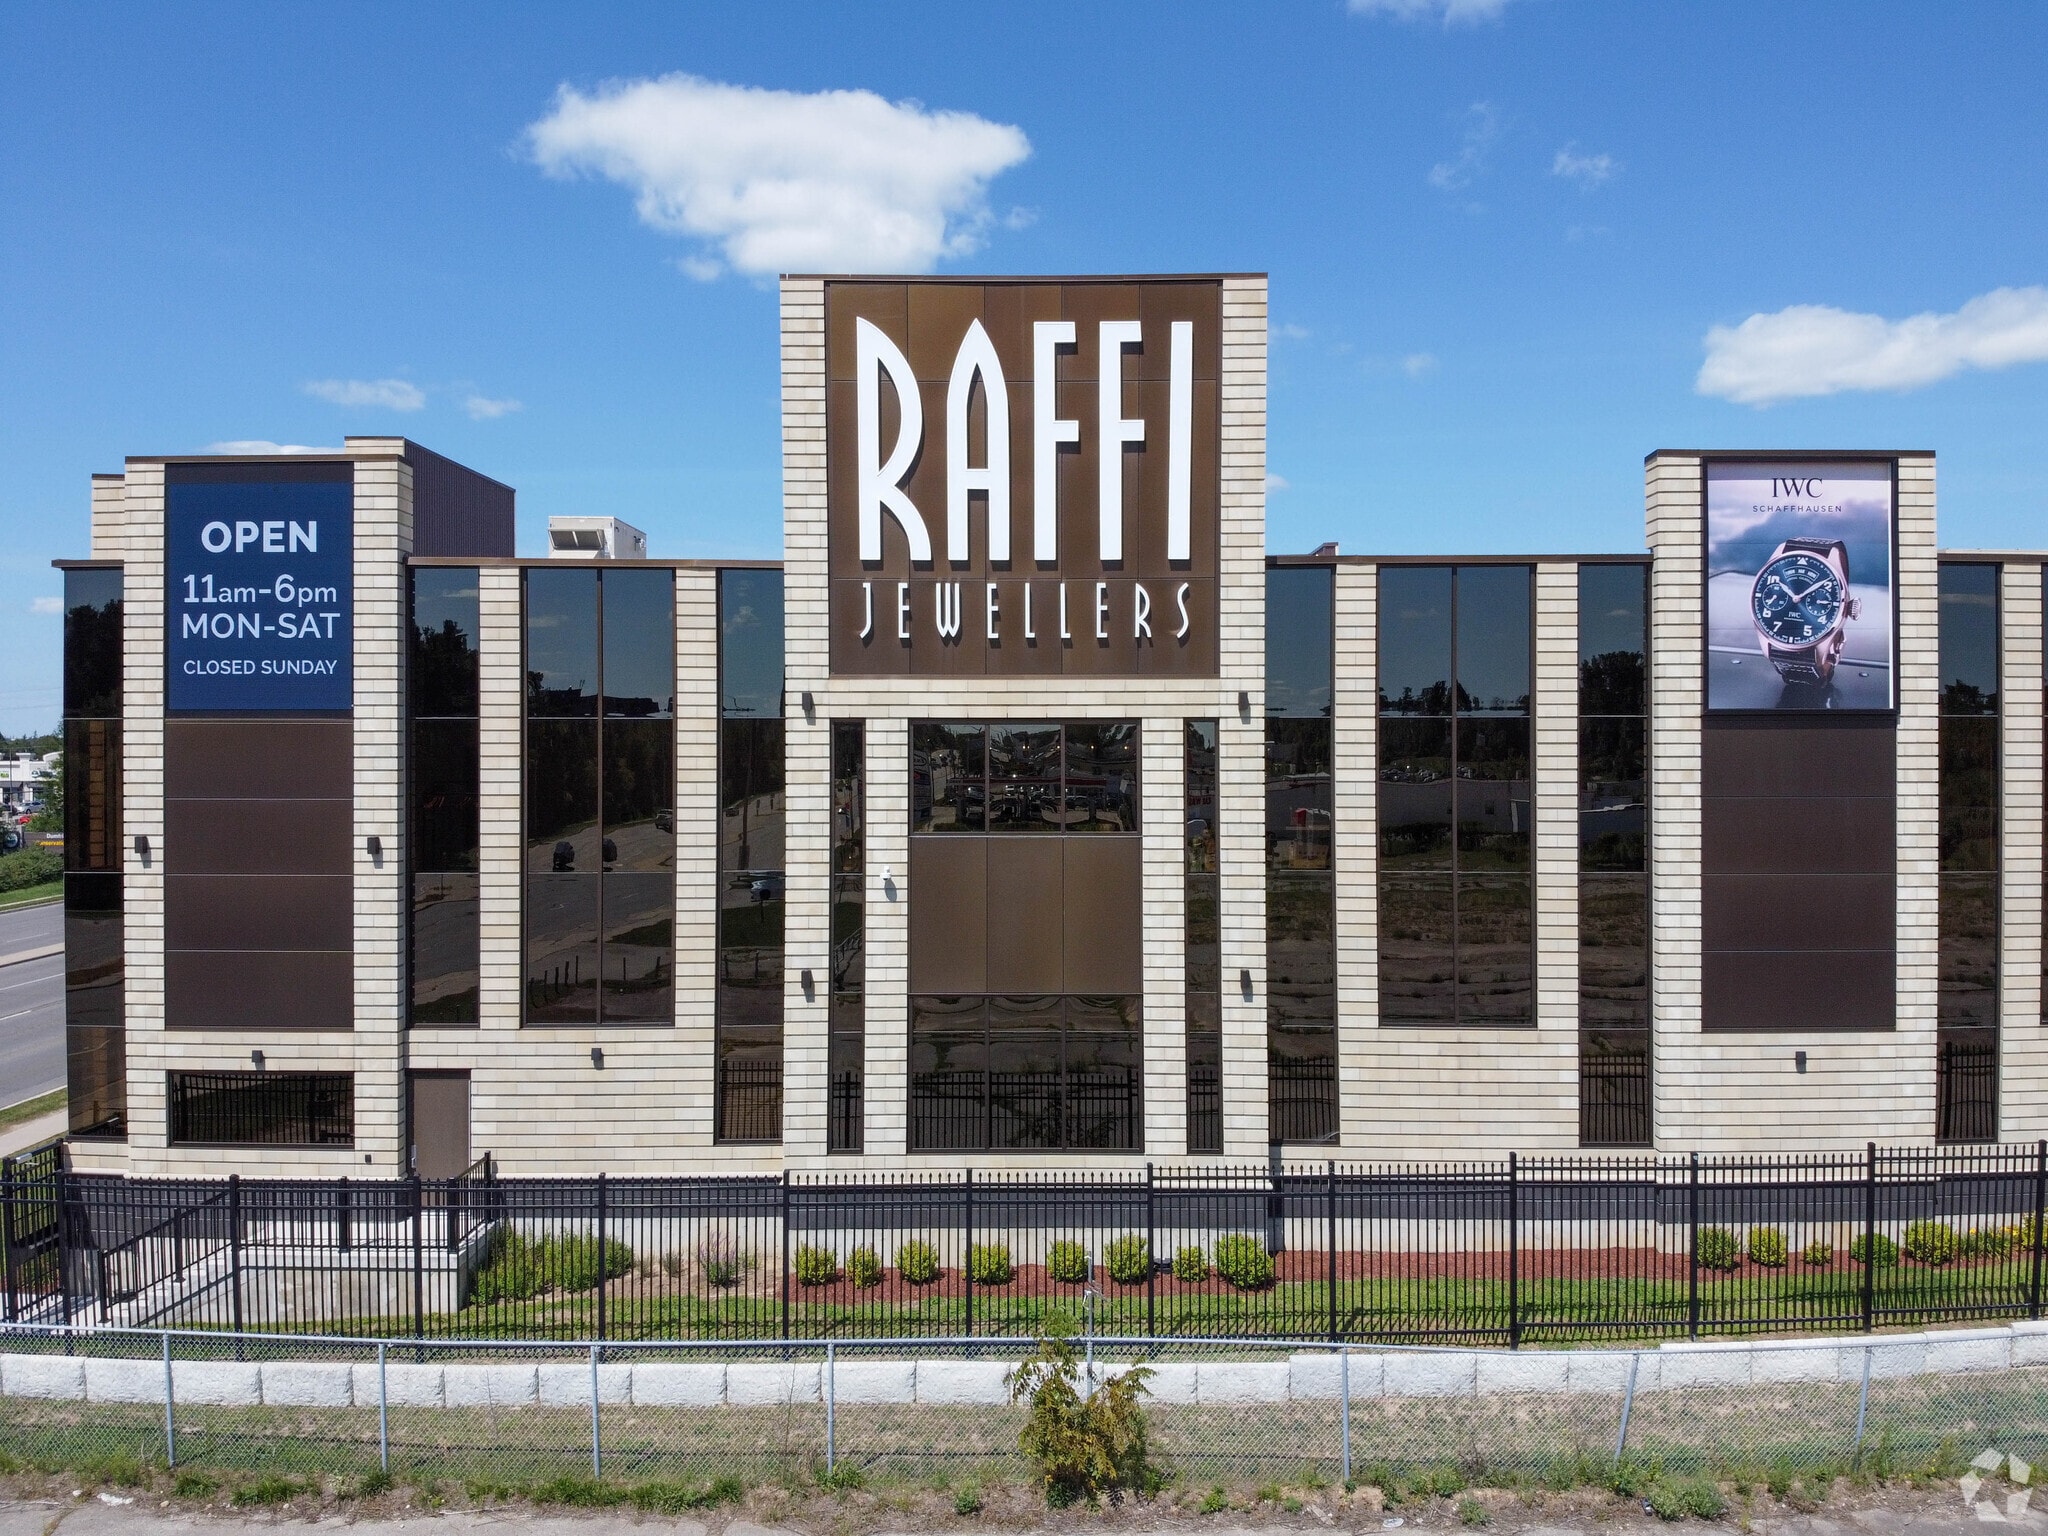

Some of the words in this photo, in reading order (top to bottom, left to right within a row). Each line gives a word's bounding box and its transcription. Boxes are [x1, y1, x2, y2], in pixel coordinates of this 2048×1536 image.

[856, 316, 1193, 560] RAFFI
[1771, 477, 1823, 498] IWC
[1752, 505, 1842, 513] SCHAFFHAUSEN
[201, 520, 317, 553] OPEN
[183, 573, 337, 607] 11am-6pm
[859, 582, 1189, 639] JEWELLERS
[182, 612, 341, 639] MON-SAT
[1803, 625, 1813, 637] 5
[183, 660, 256, 675] CLOSED
[261, 660, 338, 675] SUNDAY
